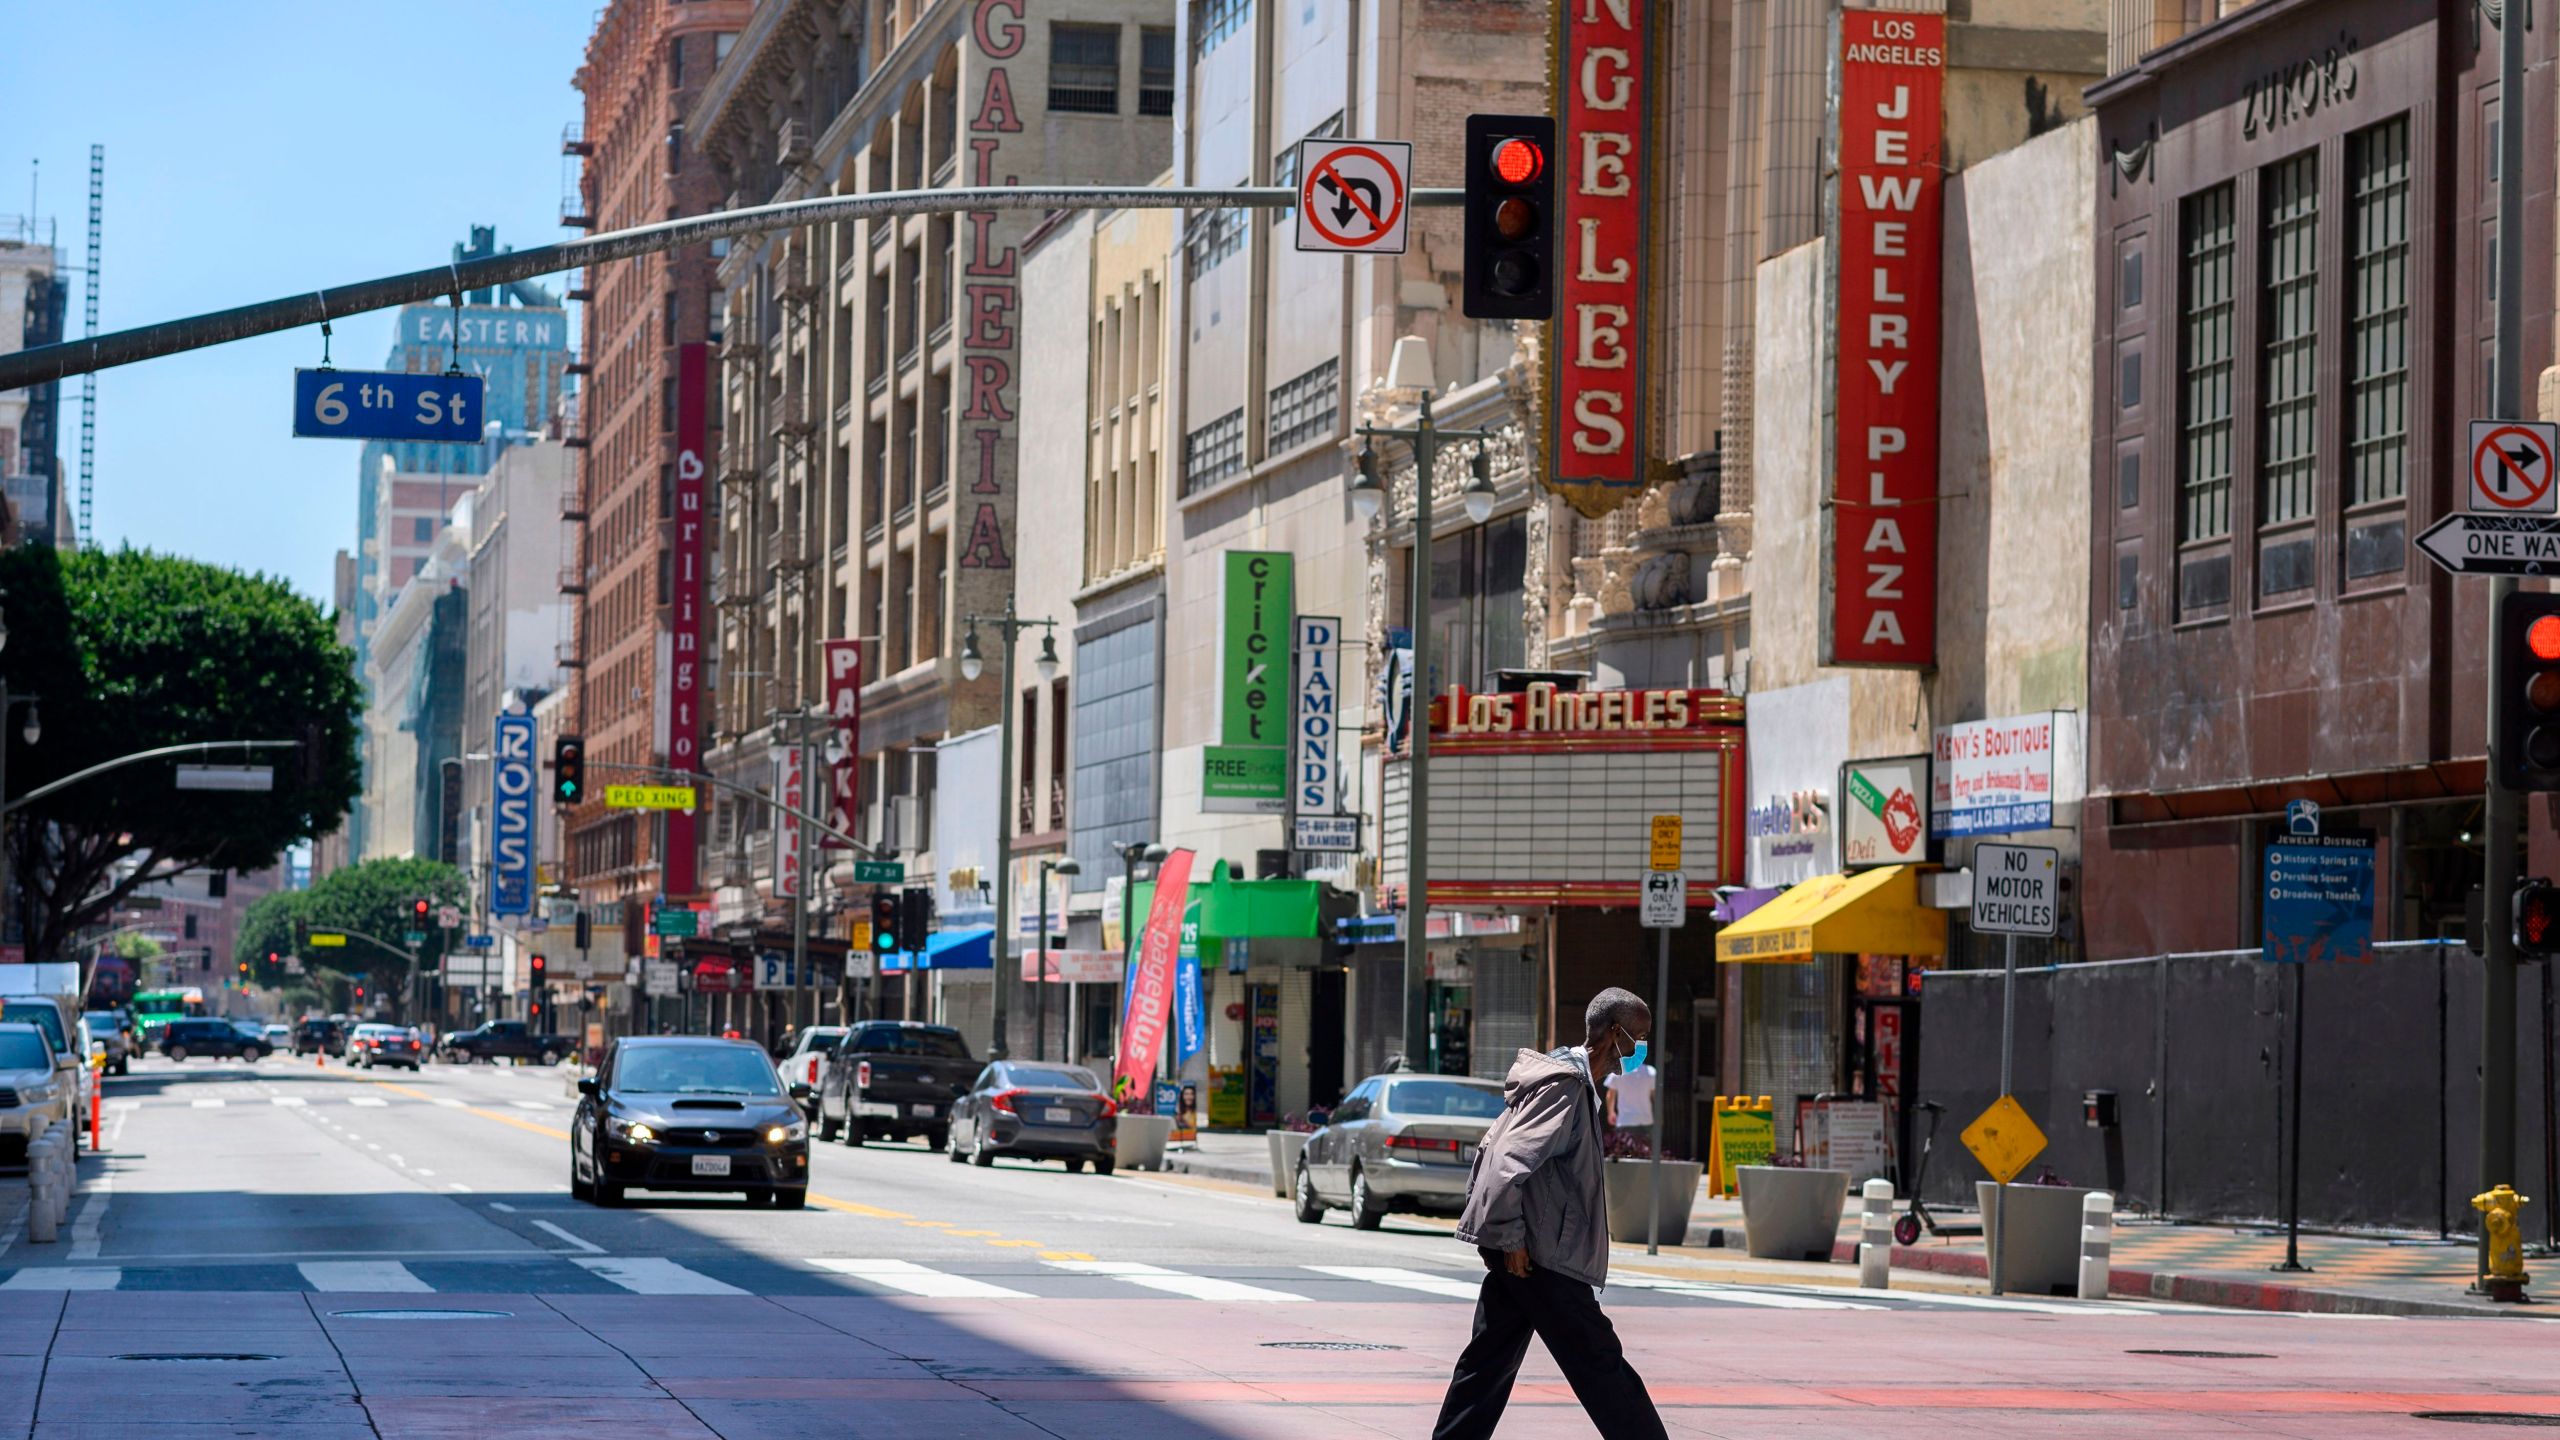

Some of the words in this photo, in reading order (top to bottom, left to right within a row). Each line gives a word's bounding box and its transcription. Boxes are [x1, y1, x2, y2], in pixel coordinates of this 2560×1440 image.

[1873, 21, 1915, 40] LOS
[1846, 43, 1941, 68] ANGELES
[1858, 86, 1922, 395] JEWELRY
[959, 0, 1026, 569] GALLERIA
[418, 316, 551, 345] EASTERN
[314, 382, 395, 426] 6th
[415, 390, 466, 427] St
[1862, 426, 1907, 645] PLAZA
[2467, 533, 2514, 556] ONE
[2523, 535, 2560, 558] WA
[1246, 556, 1270, 740] cricket
[1301, 625, 1333, 807] DIAMONDS
[1985, 724, 2049, 757] BOUTIQUE
[1205, 759, 1247, 777] FREE
[500, 725, 531, 872] ROSS
[614, 790, 645, 803] PED
[652, 791, 689, 805] XING
[1850, 781, 1876, 810] PIZZA
[2276, 834, 2320, 846] JEWELRY
[2323, 835, 2368, 847] DISTRICT
[884, 867, 897, 878] St
[2004, 850, 2028, 872] NO
[2283, 854, 2317, 864] Historic
[2320, 855, 2347, 867] Spring
[2349, 856, 2359, 865] St
[1986, 875, 2044, 900] MOTOR
[2283, 872, 2319, 884] Pershing
[2320, 872, 2348, 884] Square
[1652, 893, 1674, 904] ONLY
[2282, 888, 2323, 902] Broadway
[1977, 902, 2051, 927] VEHICLES
[766, 961, 778, 983] P
[1129, 927, 1170, 1062] pageplus
